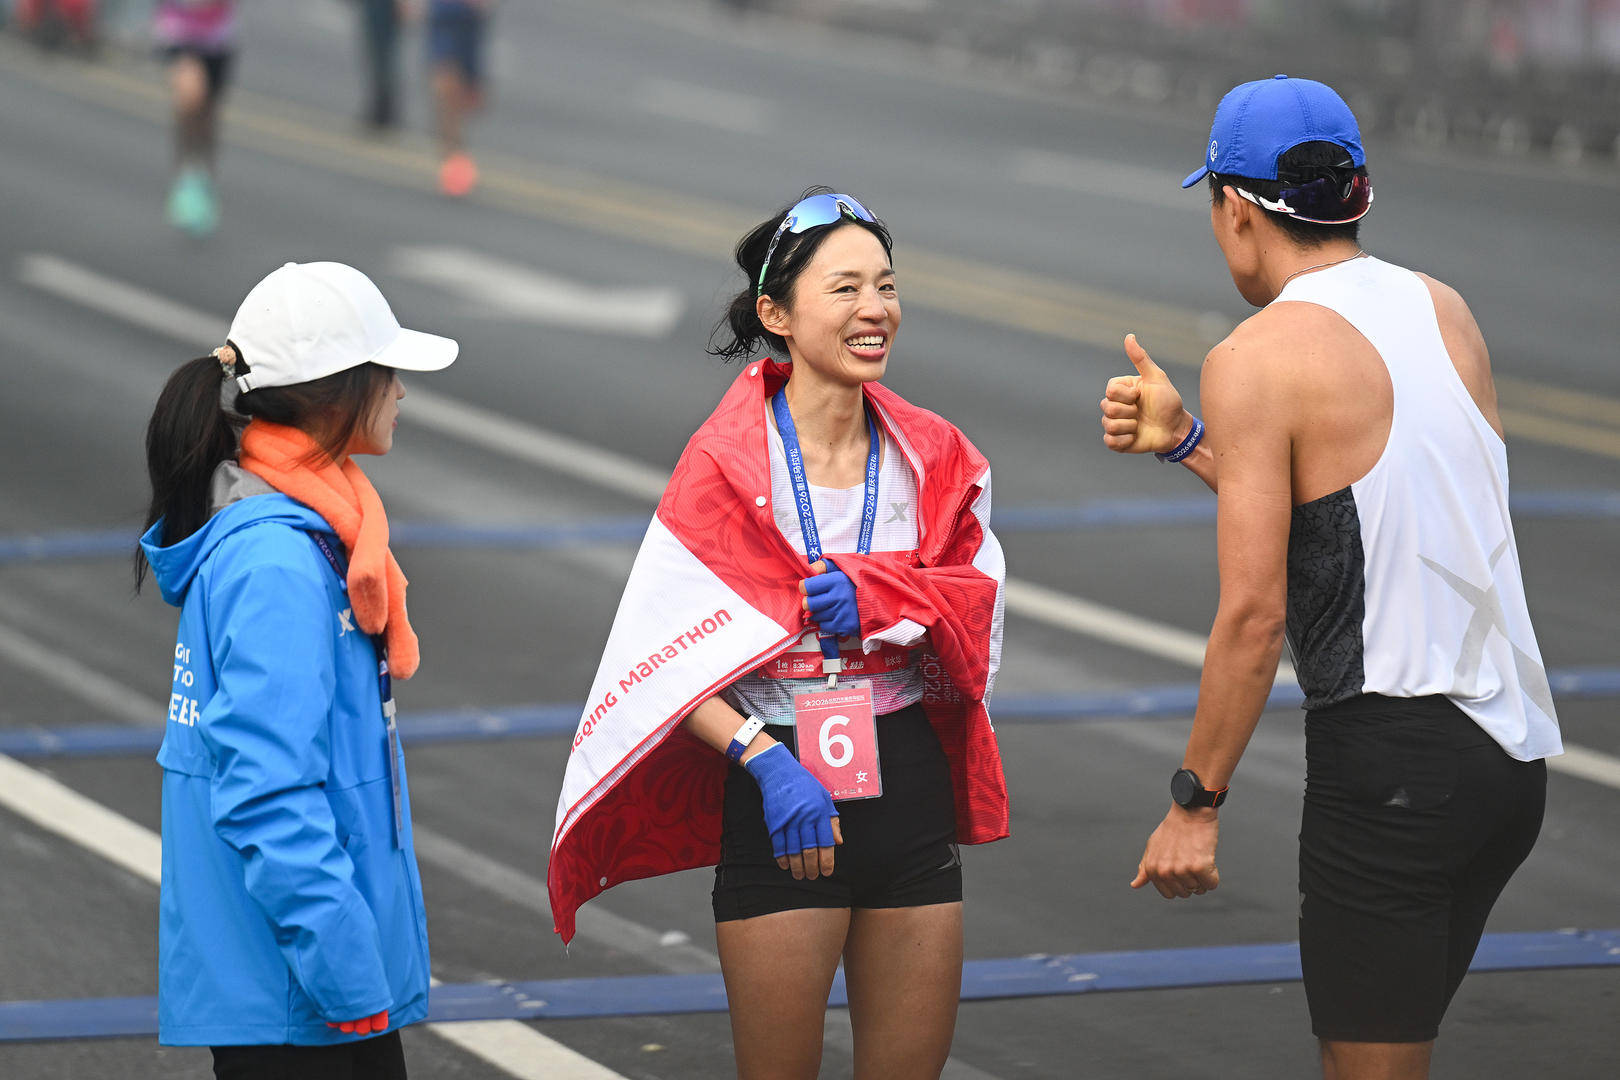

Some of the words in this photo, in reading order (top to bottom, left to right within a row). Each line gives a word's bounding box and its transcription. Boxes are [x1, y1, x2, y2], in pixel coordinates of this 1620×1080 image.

[790, 448, 811, 518] 2026重庆马拉松
[866, 454, 877, 520] 2026重庆马拉松
[819, 715, 854, 768] 6
[856, 770, 868, 783] 女
